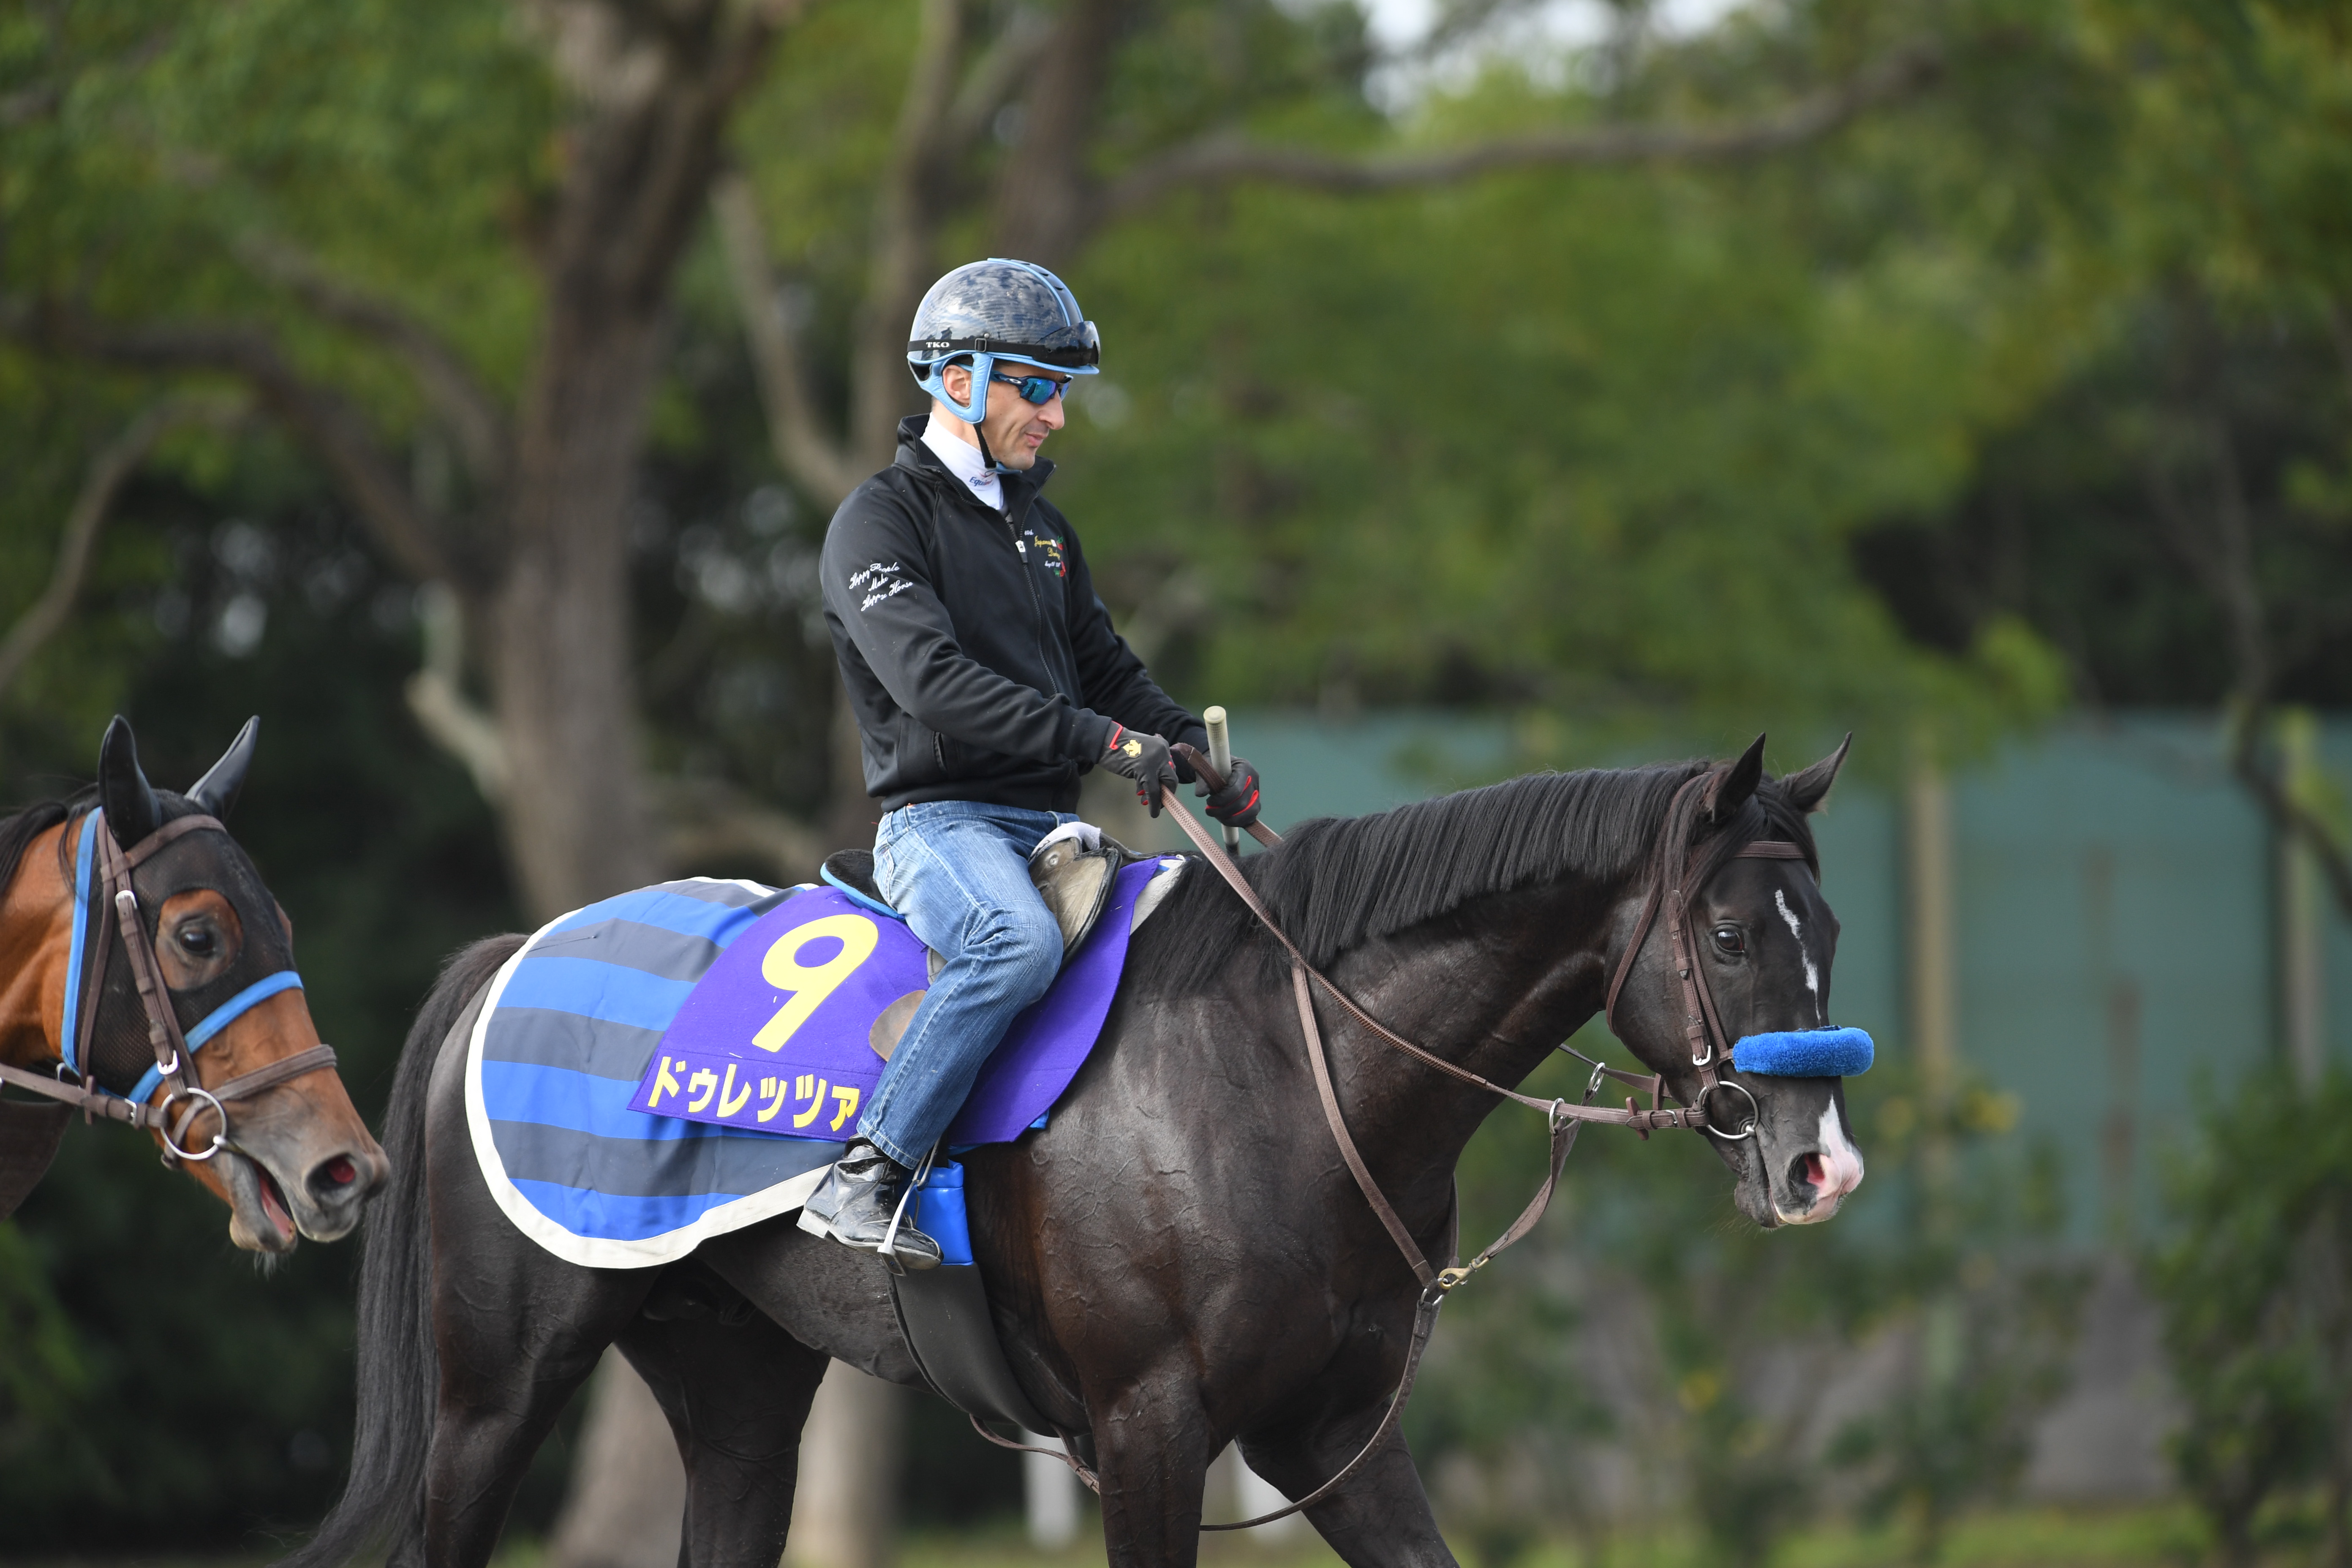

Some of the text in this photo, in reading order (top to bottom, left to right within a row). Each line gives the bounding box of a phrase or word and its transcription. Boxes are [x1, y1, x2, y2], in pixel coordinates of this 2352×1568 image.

[870, 561, 900, 573] People
[868, 573, 889, 591] Make
[888, 580, 913, 596] Horse
[752, 914, 879, 1053] 9
[648, 1056, 860, 1132] ドゥレッツァ
